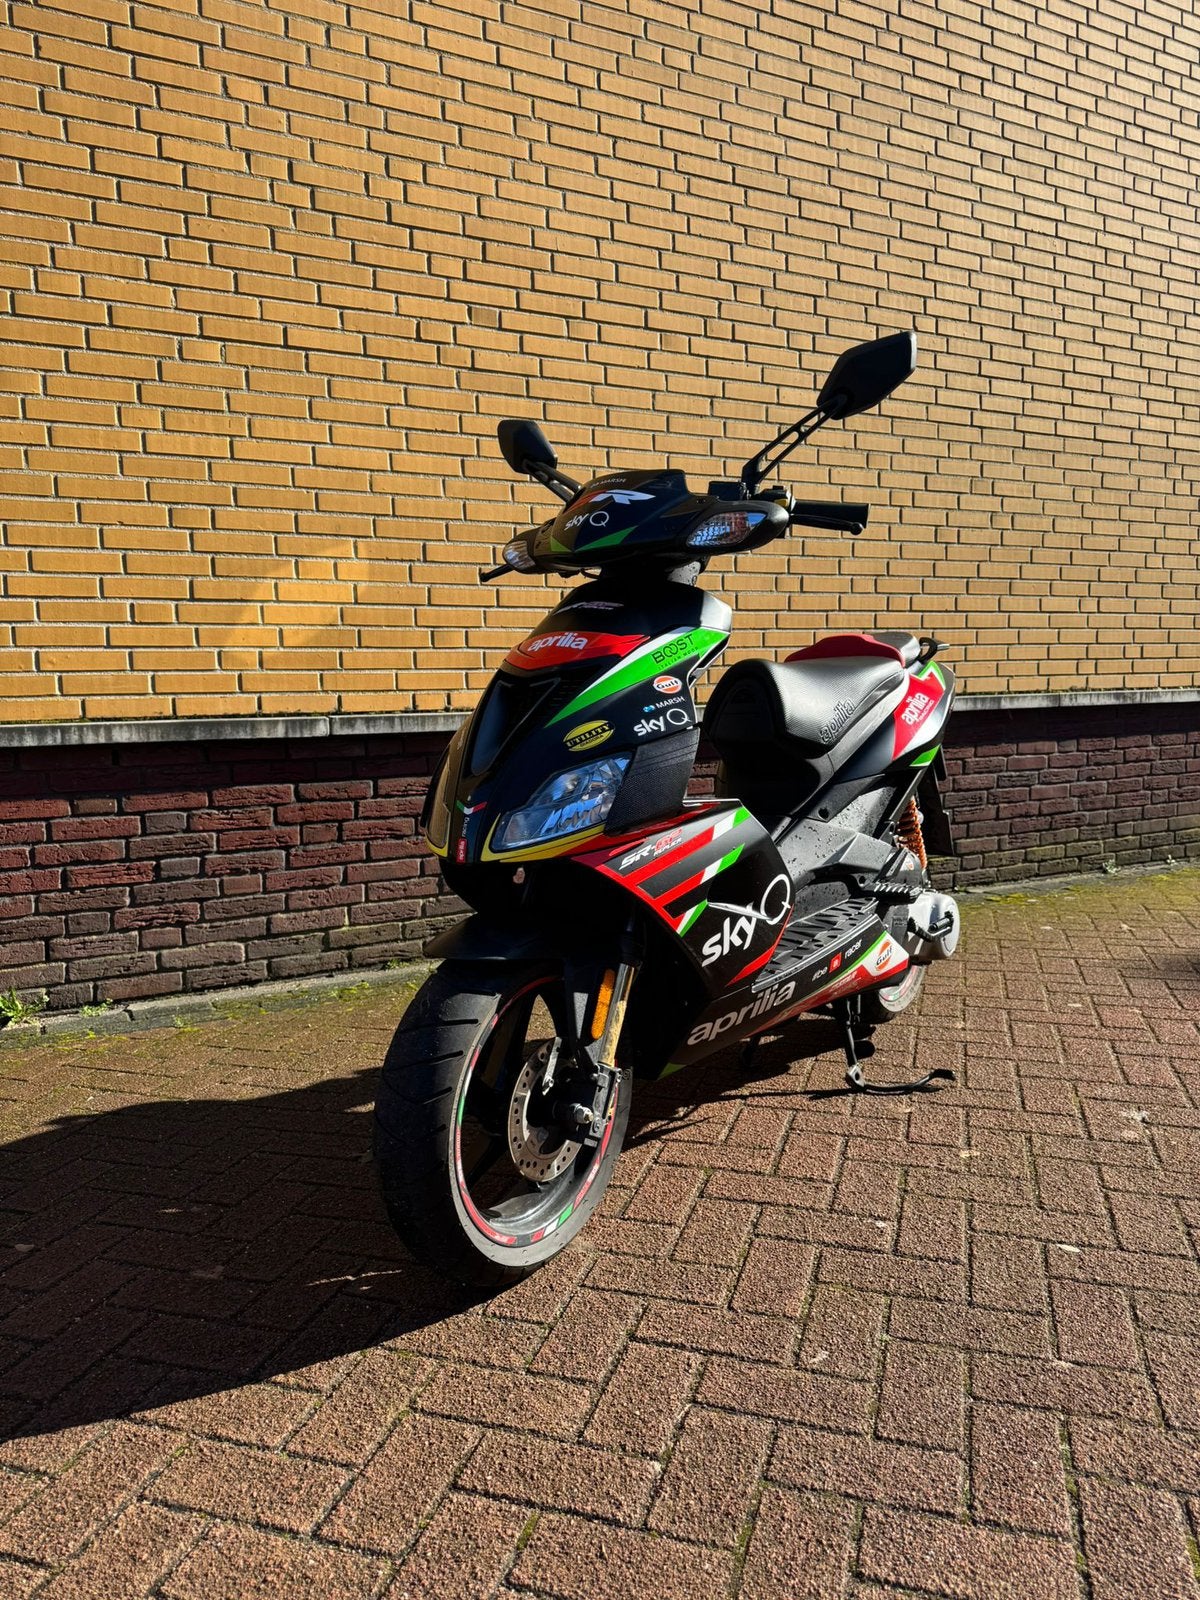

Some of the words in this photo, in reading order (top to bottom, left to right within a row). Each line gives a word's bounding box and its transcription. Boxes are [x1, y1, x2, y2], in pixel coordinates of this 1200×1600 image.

[564, 513, 589, 531] sky
[589, 511, 610, 527] Q
[527, 632, 588, 652] aprilia
[651, 634, 695, 664] BOOST
[656, 679, 679, 690] Gulf
[656, 696, 686, 709] MARSH
[901, 692, 930, 726] aprilia
[633, 716, 666, 737] sky
[666, 708, 692, 726] Q
[818, 698, 856, 743] aprilia
[566, 723, 609, 747] UTILITY
[461, 816, 470, 838] racing
[701, 900, 757, 968] sky
[760, 873, 791, 925] Q
[844, 938, 863, 960] racer
[876, 944, 893, 966] Gulf
[686, 980, 797, 1046] aprilia
